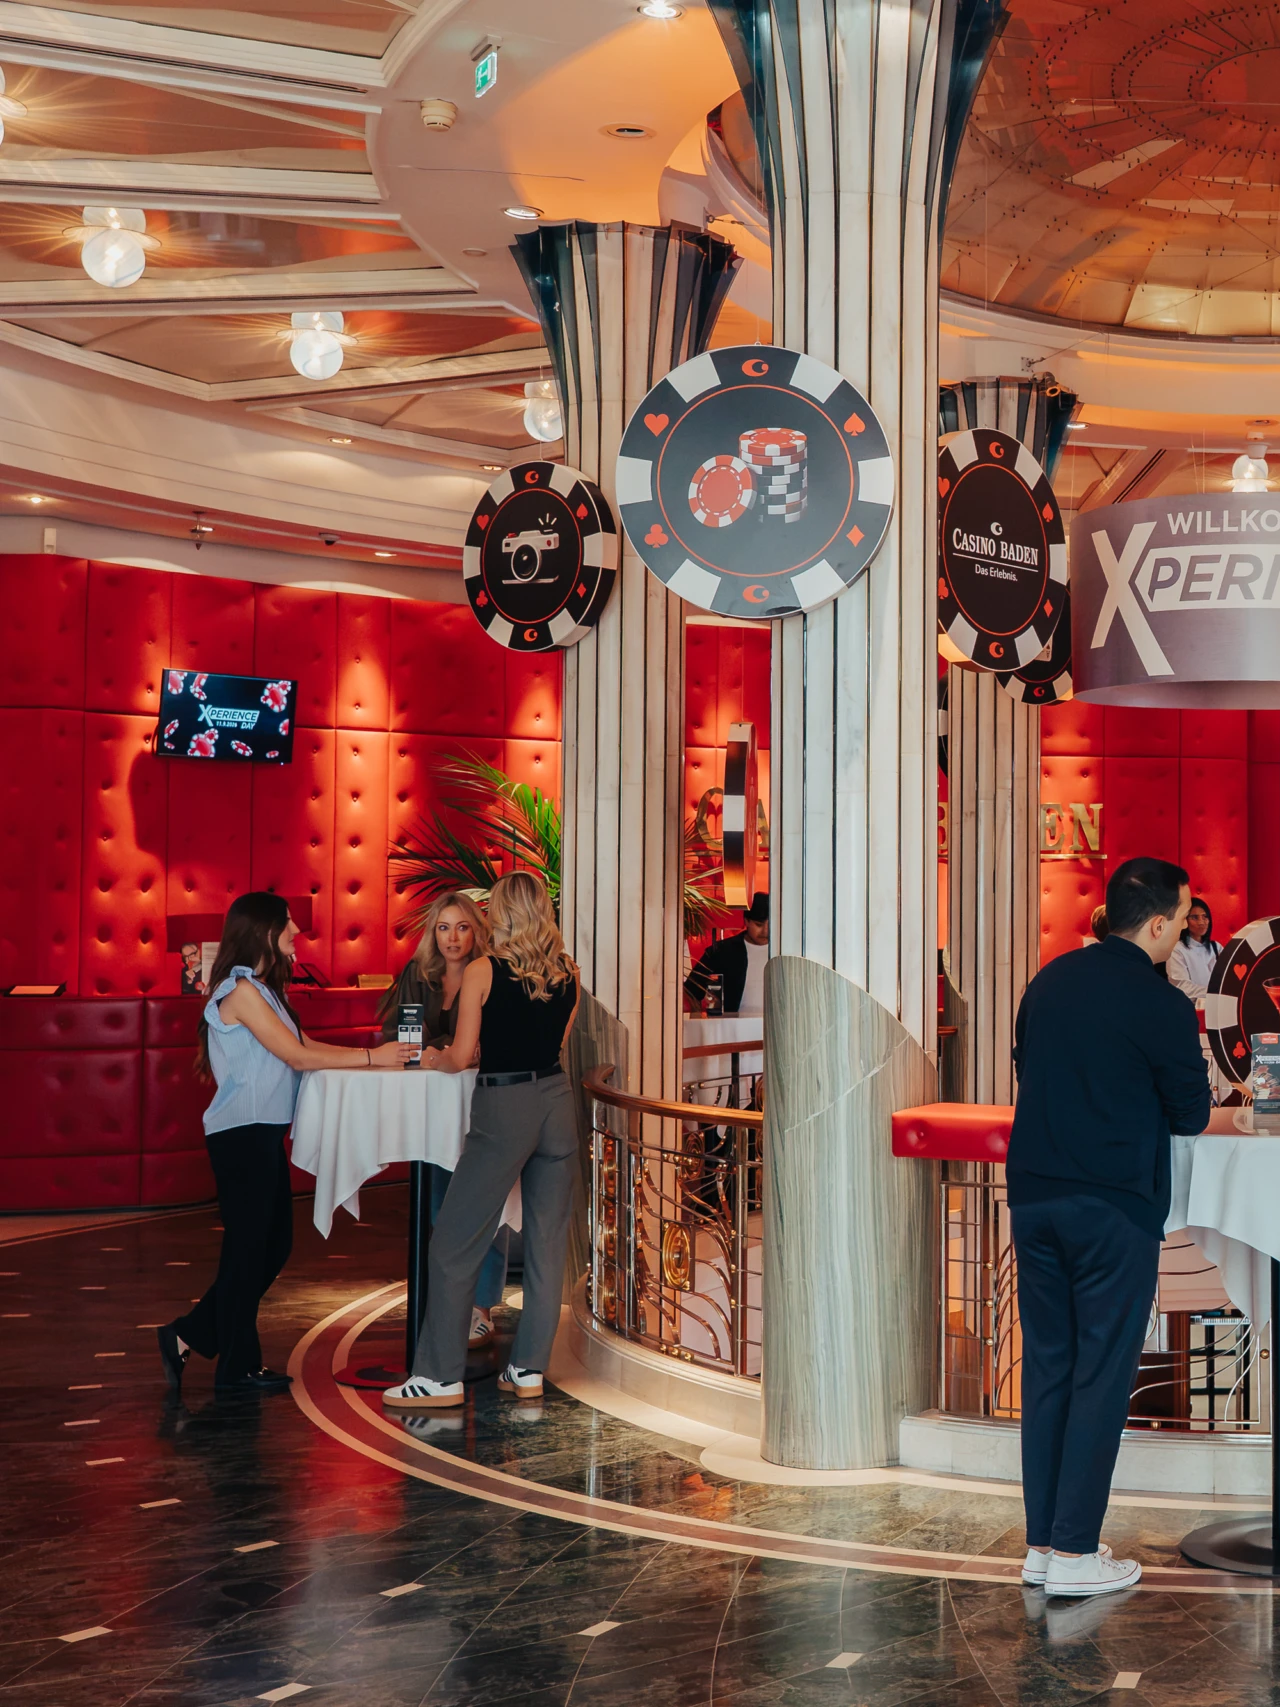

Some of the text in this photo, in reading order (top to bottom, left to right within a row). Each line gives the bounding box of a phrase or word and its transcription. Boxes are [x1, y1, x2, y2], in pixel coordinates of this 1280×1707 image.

[953, 528, 1038, 566] CASINO BADEN
[975, 564, 1018, 581] Das Erlebnis.
[198, 704, 259, 727] XPERIENCE
[240, 721, 256, 730] DAY
